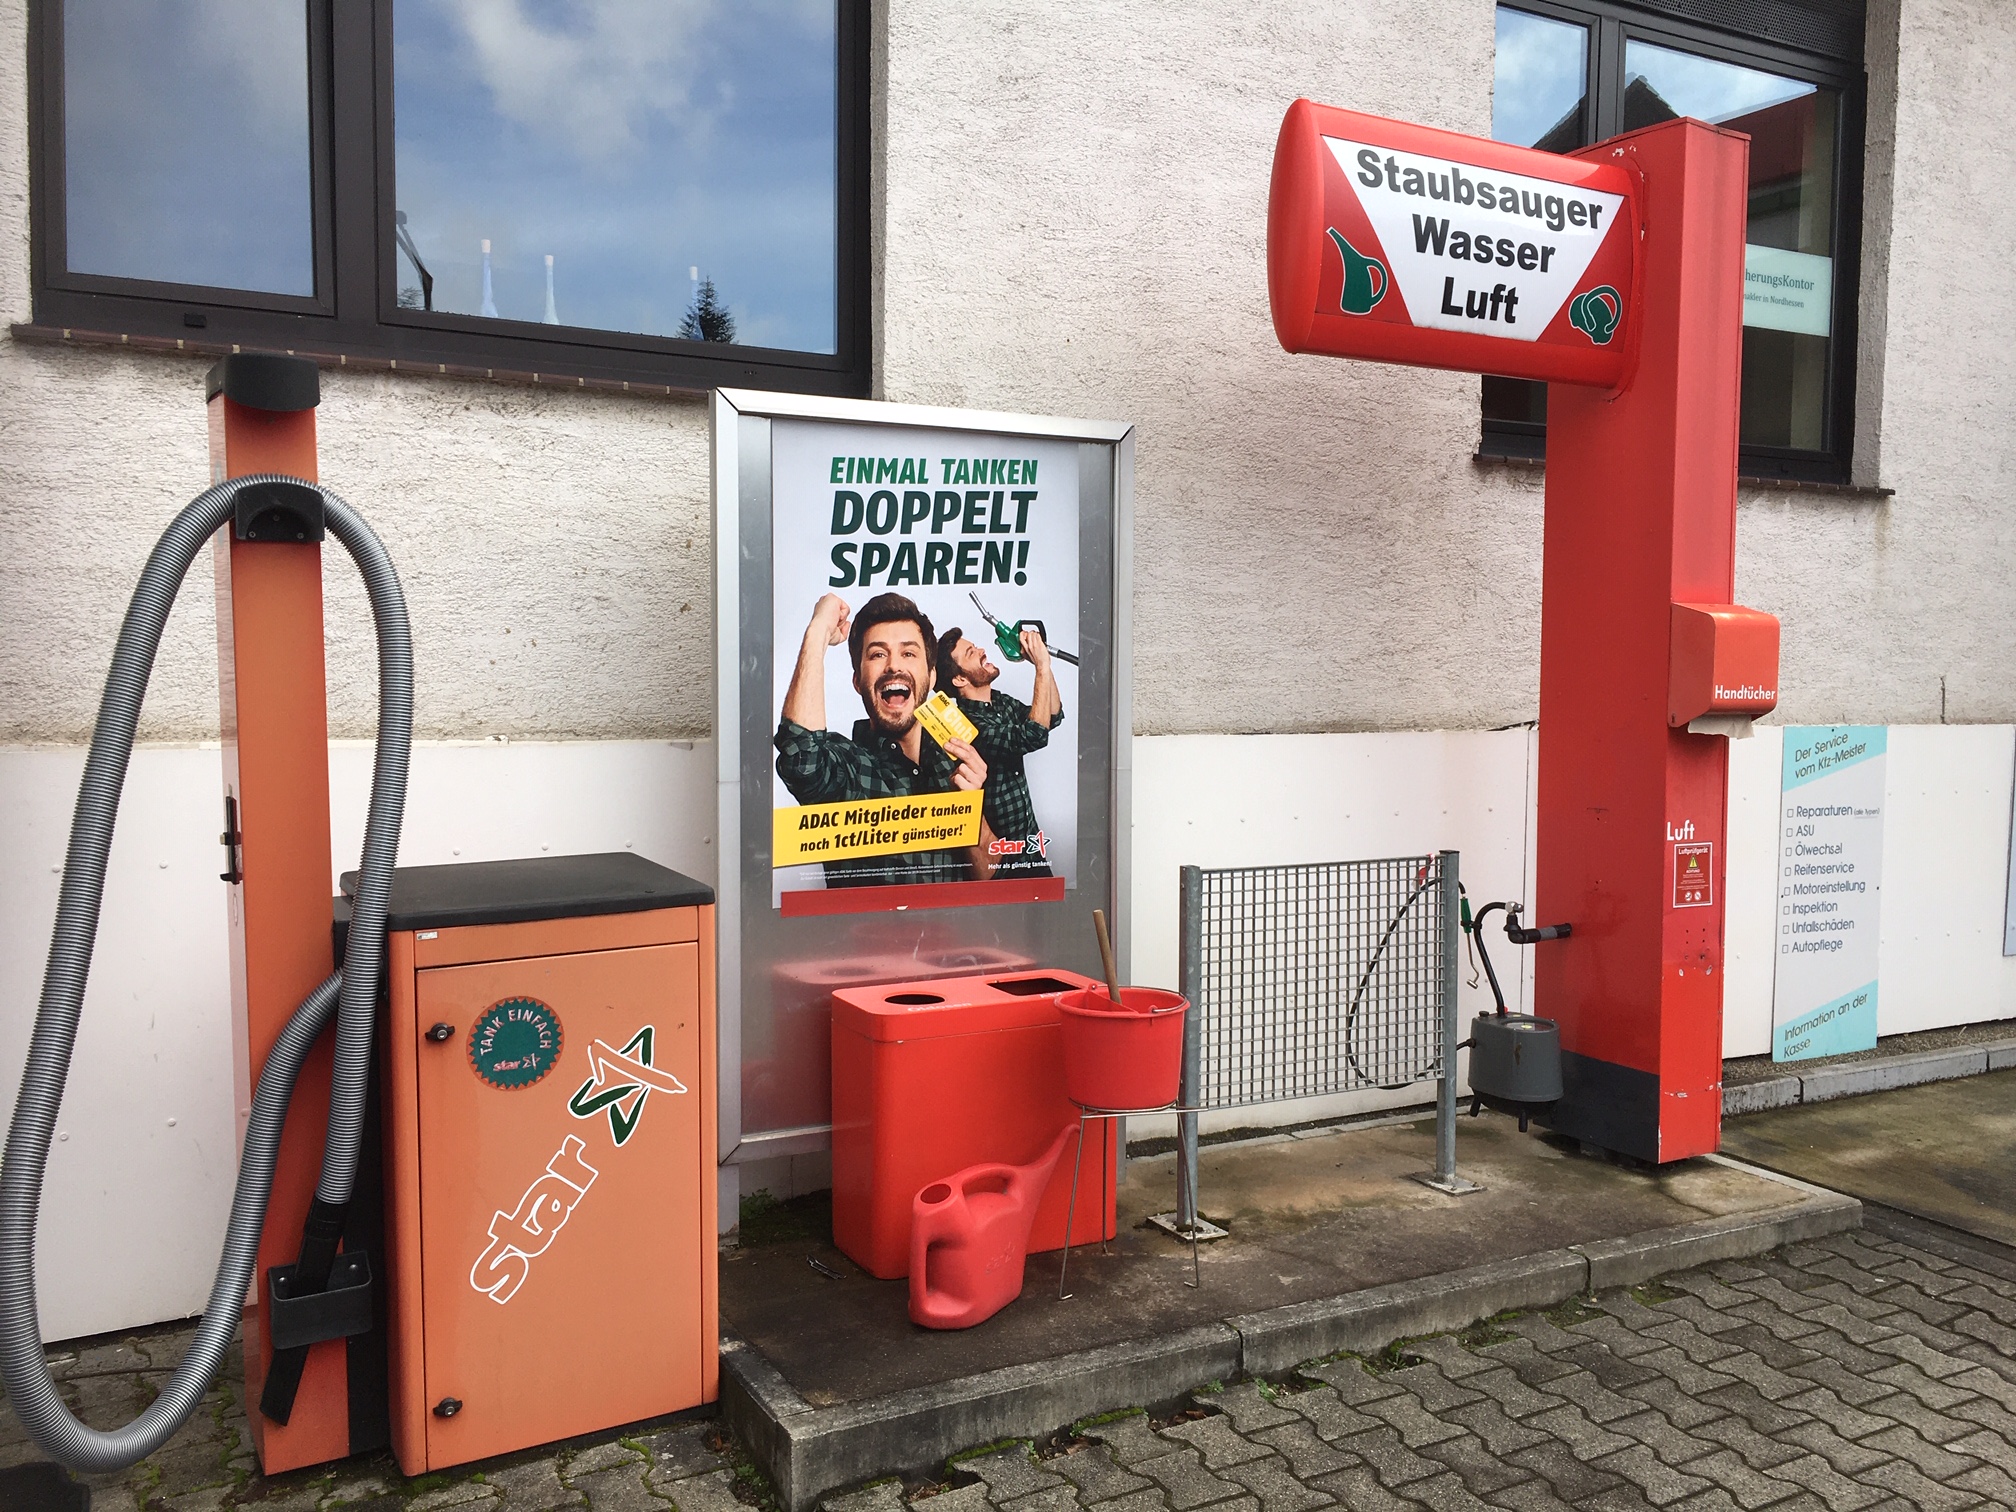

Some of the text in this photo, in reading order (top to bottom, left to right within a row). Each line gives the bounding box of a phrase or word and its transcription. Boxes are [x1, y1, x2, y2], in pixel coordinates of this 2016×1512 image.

[1357, 149, 1602, 231] Staubsauger
[1412, 213, 1556, 273] Wasser
[1745, 268, 1815, 291] herungsKontor
[1441, 276, 1519, 324] Luft
[830, 457, 1038, 485] EINMAL TANKEN
[830, 490, 1038, 535] DOPPELT
[828, 540, 1030, 588] SPAREN!
[1714, 685, 1776, 700] Handtücher
[1795, 733, 1848, 763] Der Service
[1794, 742, 1867, 779] vom Kfz-Meister
[799, 804, 972, 830] ADAC Mitglieder tanken
[1796, 805, 1853, 819] Reparaturen
[800, 838, 830, 852] noch
[834, 828, 899, 848] 1ct/Liter
[1666, 819, 1695, 841] Luft
[1796, 825, 1815, 837] ASU
[988, 837, 1026, 855] star
[1011, 861, 1032, 870] günstig
[1794, 862, 1855, 876] Reifenservice
[1793, 881, 1866, 895] Motoreinstellung
[1792, 901, 1838, 916] Inspektion
[1792, 918, 1855, 934] Unfallschäden
[1792, 939, 1843, 954] Autopflege
[1784, 993, 1868, 1041] Information an der
[480, 1009, 552, 1056] TANK EINFACH
[1784, 1038, 1811, 1059] Kasse
[493, 1060, 520, 1071] star
[470, 1134, 599, 1304] star
